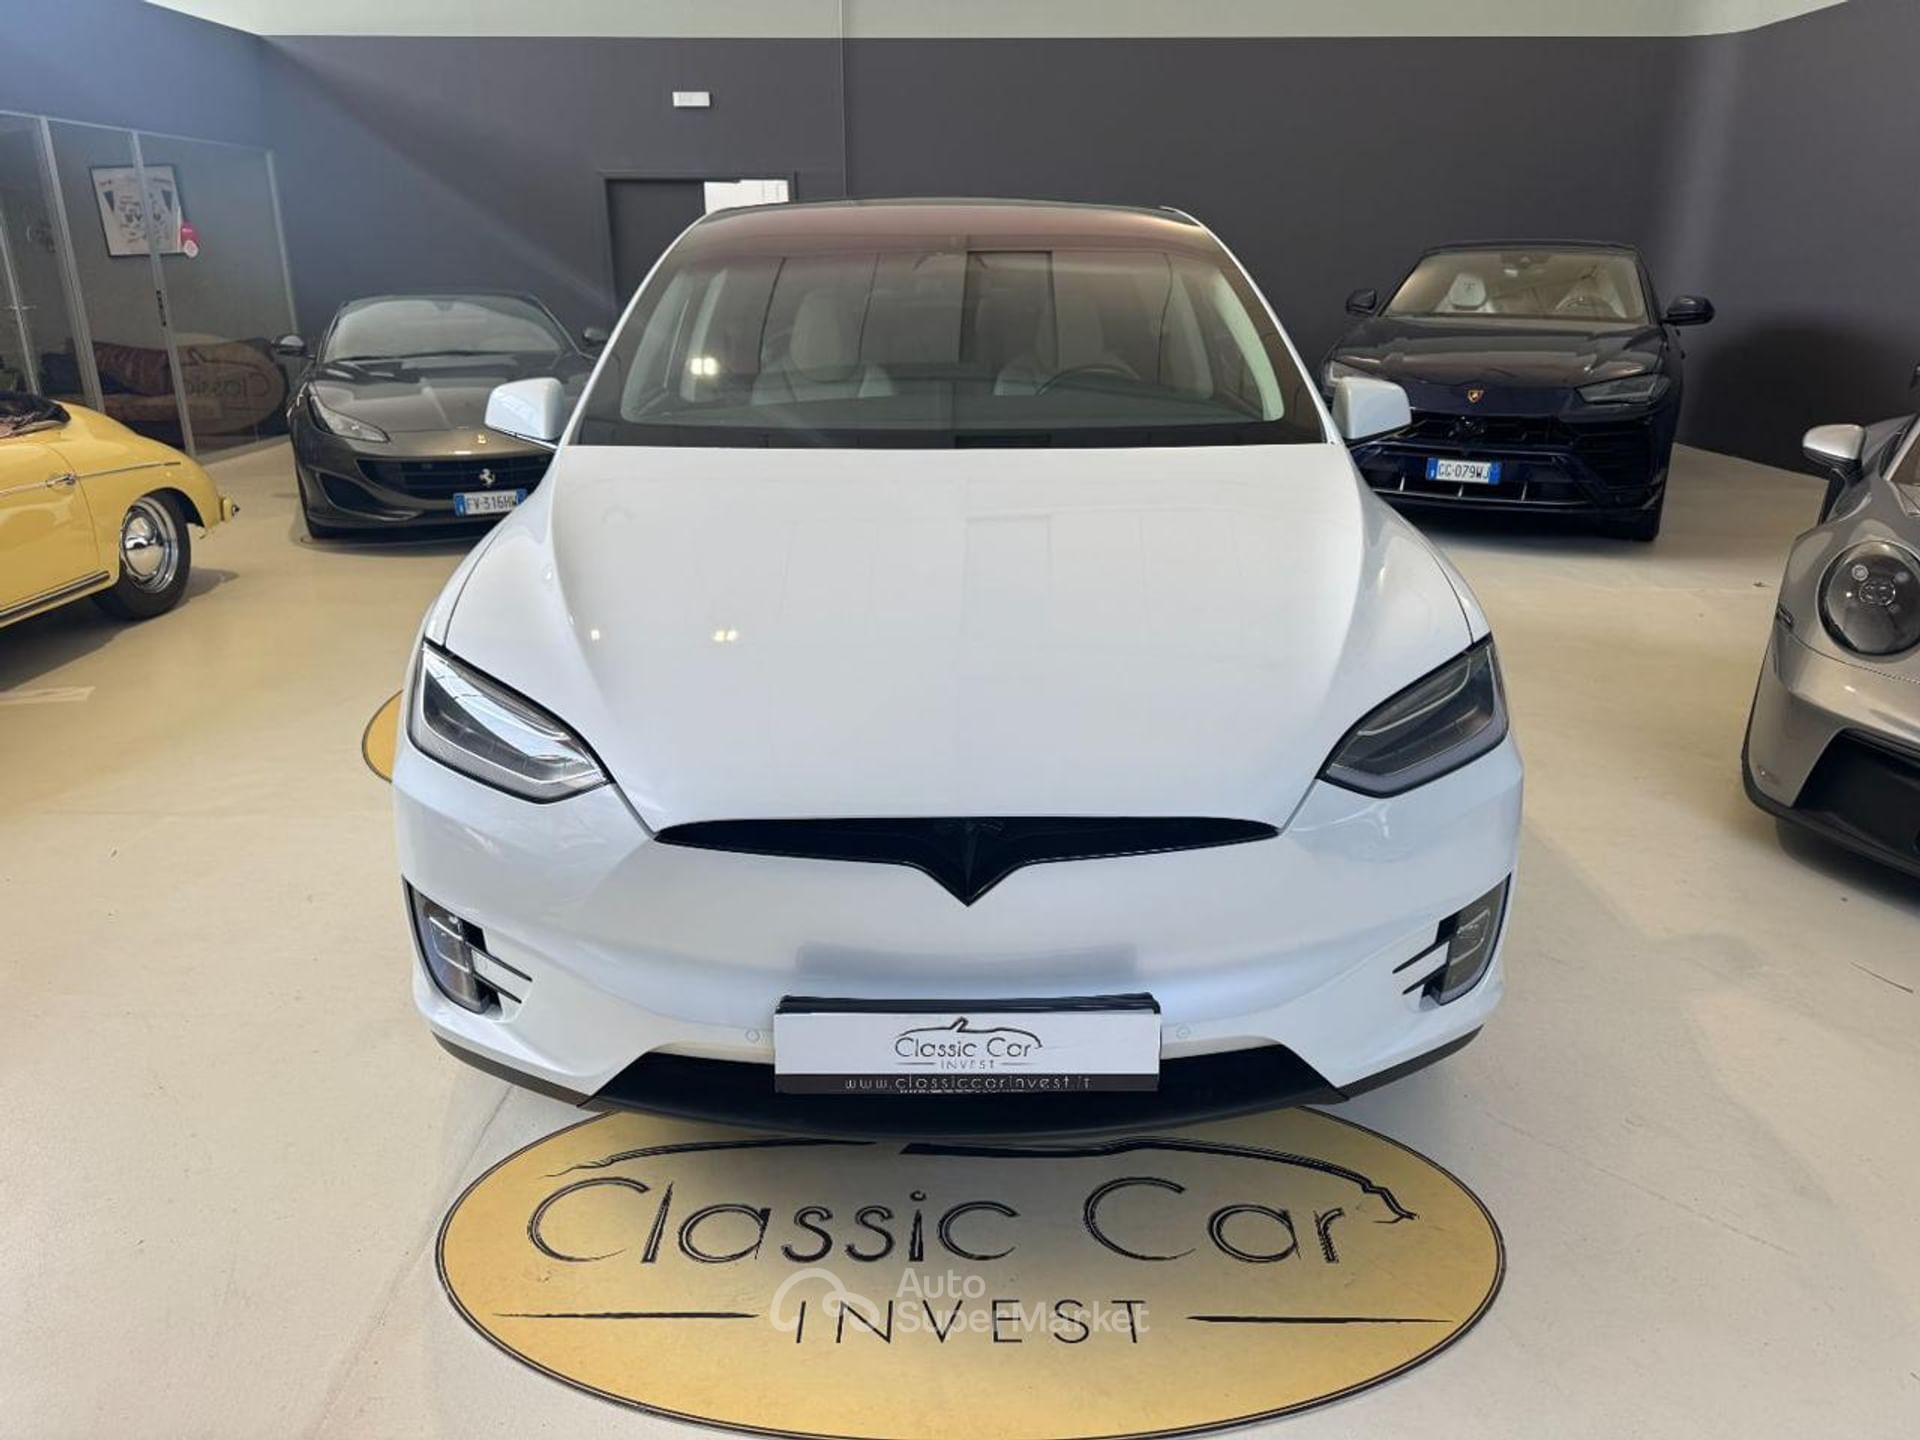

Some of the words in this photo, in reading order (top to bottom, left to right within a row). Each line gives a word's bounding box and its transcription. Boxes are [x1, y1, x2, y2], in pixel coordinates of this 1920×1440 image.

[895, 1036, 977, 1057] Classic
[987, 1036, 1032, 1057] Car
[940, 1059, 994, 1070] INVEST
[844, 1073, 1091, 1090] www.classiccarinvest.it
[527, 1176, 1020, 1263] Classic
[1083, 1176, 1344, 1263] Car
[796, 1300, 1147, 1344] INVEST
